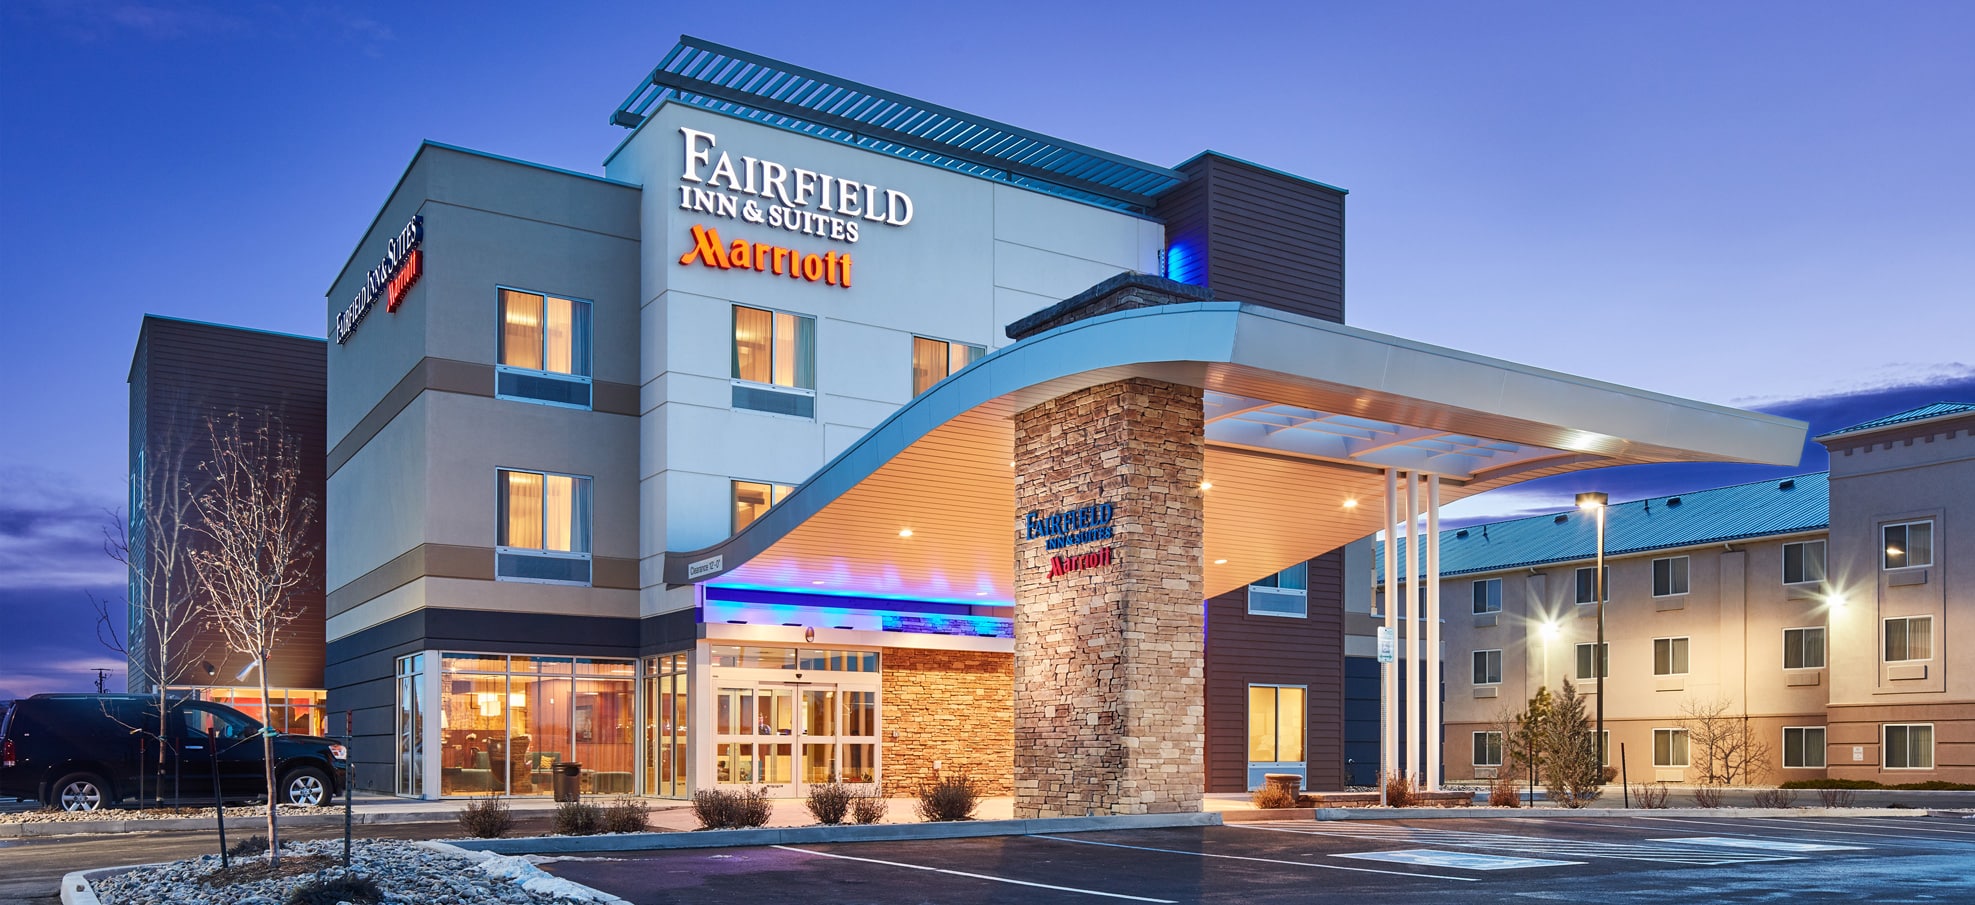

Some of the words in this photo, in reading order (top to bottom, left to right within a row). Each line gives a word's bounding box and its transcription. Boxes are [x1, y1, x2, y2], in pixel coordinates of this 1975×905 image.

[679, 126, 914, 227] FAIRFIELD
[679, 185, 738, 218] INN
[742, 200, 765, 223] &
[768, 204, 859, 243] SUITES
[336, 286, 367, 344] FAIRFIELD
[366, 264, 381, 303] INN
[387, 215, 420, 274] SUITES
[678, 223, 852, 287] Marriott
[1025, 503, 1113, 541] FAIRFIELD
[1045, 536, 1065, 551] INN
[1065, 533, 1075, 546] &
[1075, 526, 1112, 545] SUITES
[1046, 546, 1111, 579] Marriott
